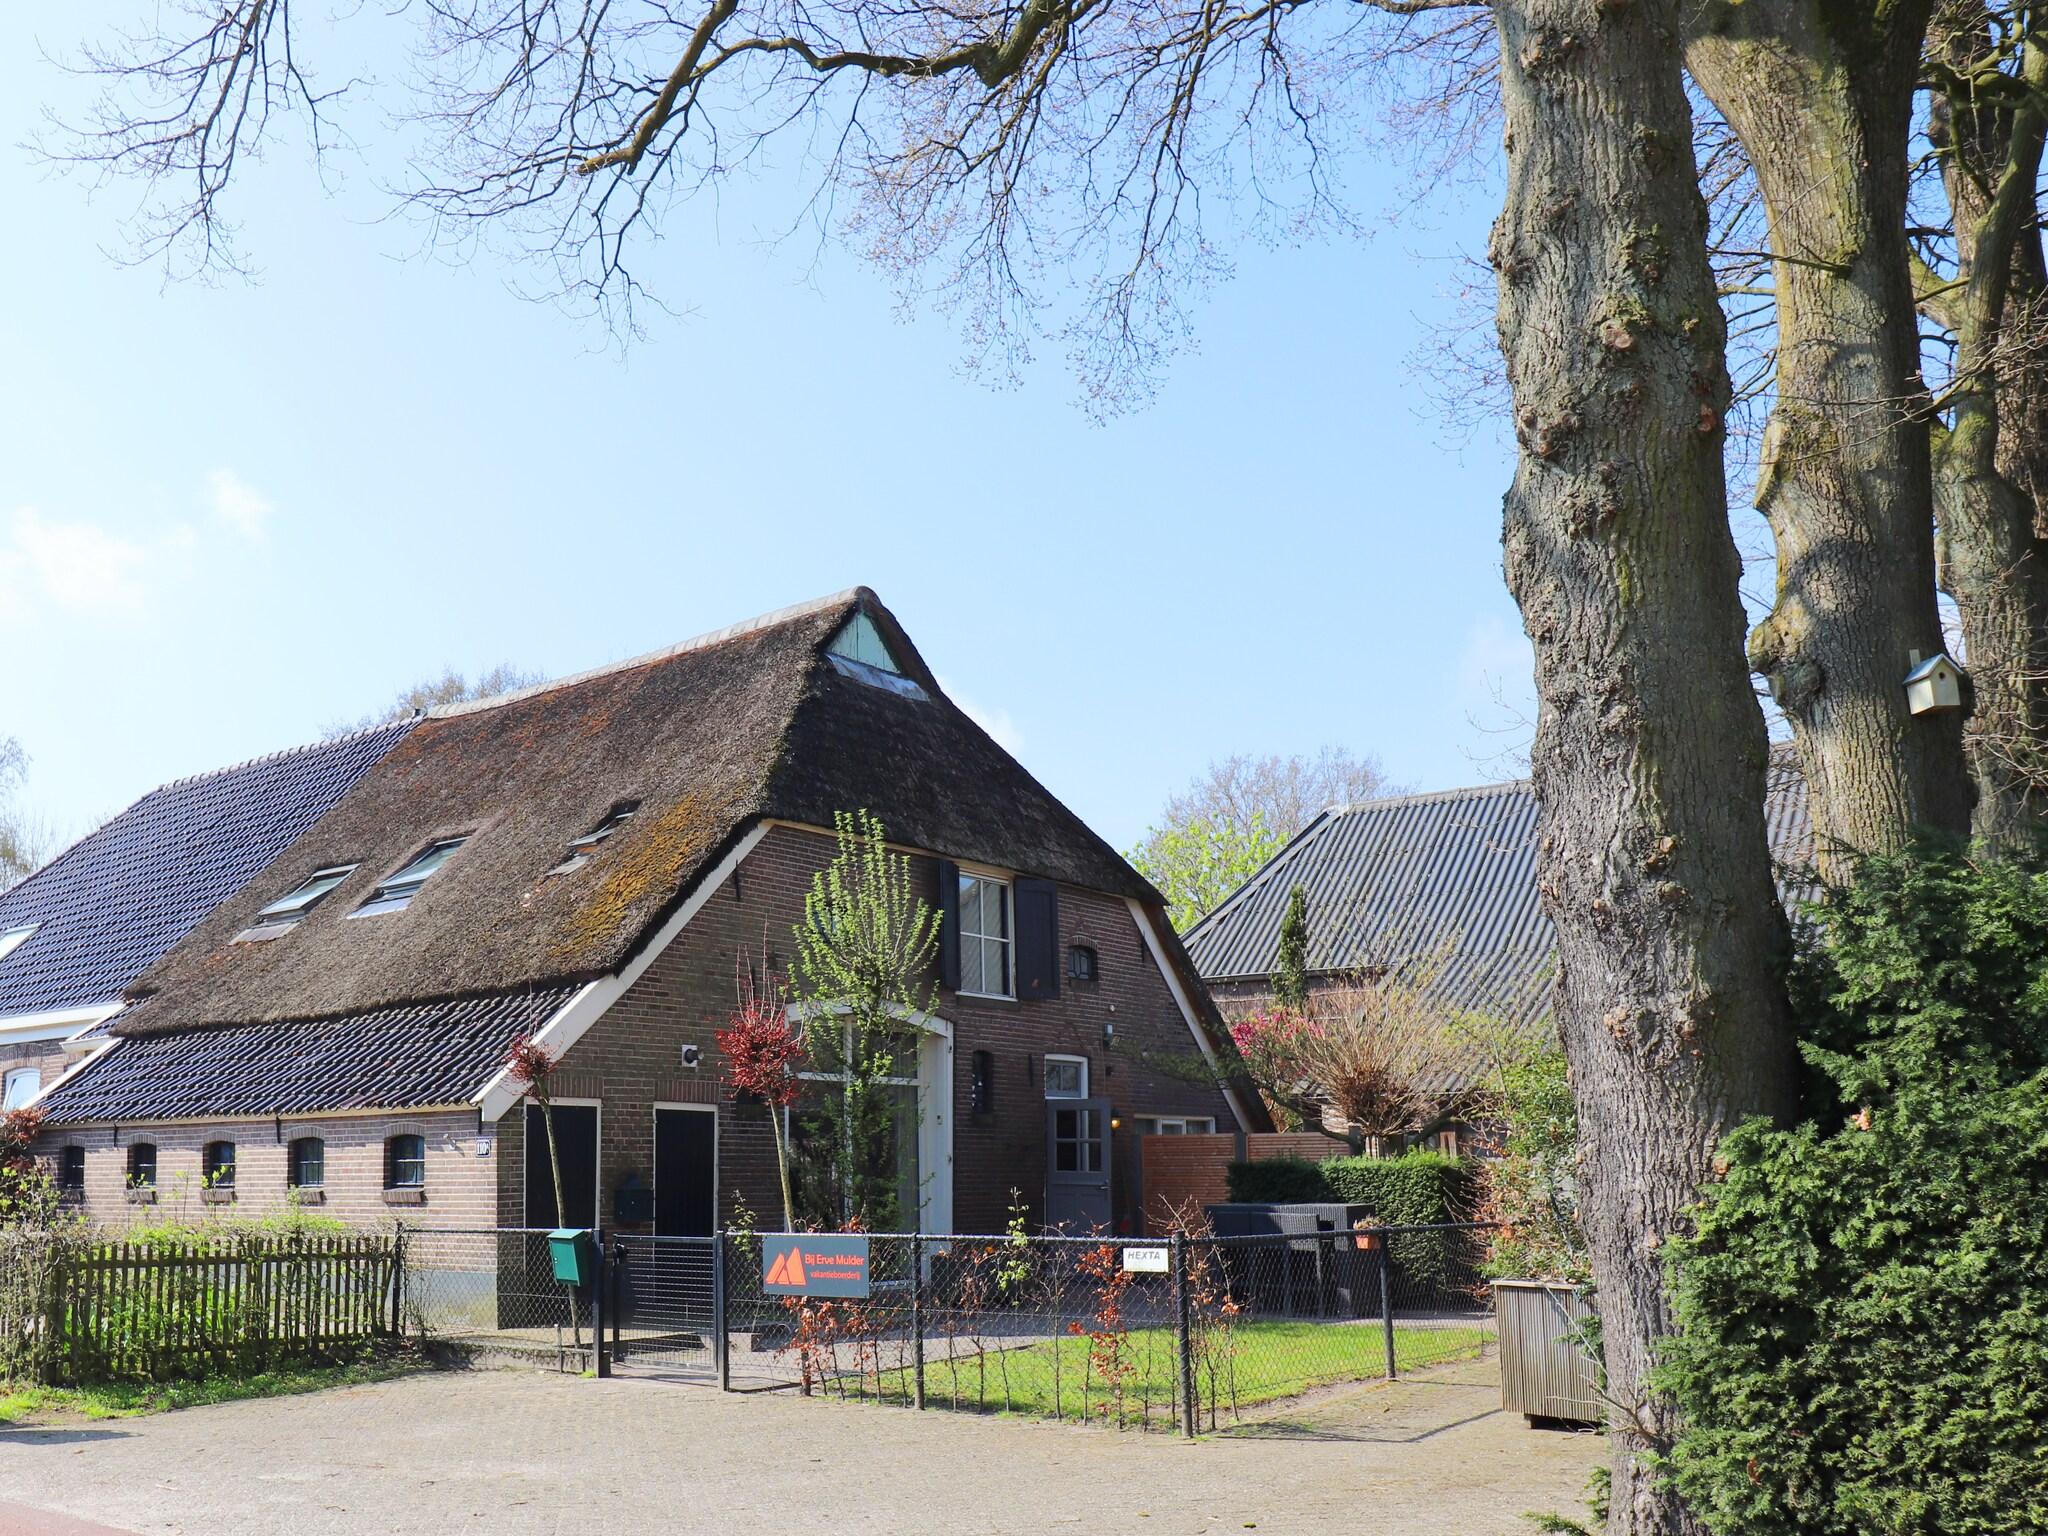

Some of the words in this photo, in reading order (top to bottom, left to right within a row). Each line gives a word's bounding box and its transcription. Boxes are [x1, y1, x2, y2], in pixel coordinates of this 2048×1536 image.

[805, 1254, 815, 1266] Bij
[816, 1254, 834, 1265] Erve
[836, 1255, 865, 1265] Mulder
[1127, 1251, 1160, 1260] HEXTA
